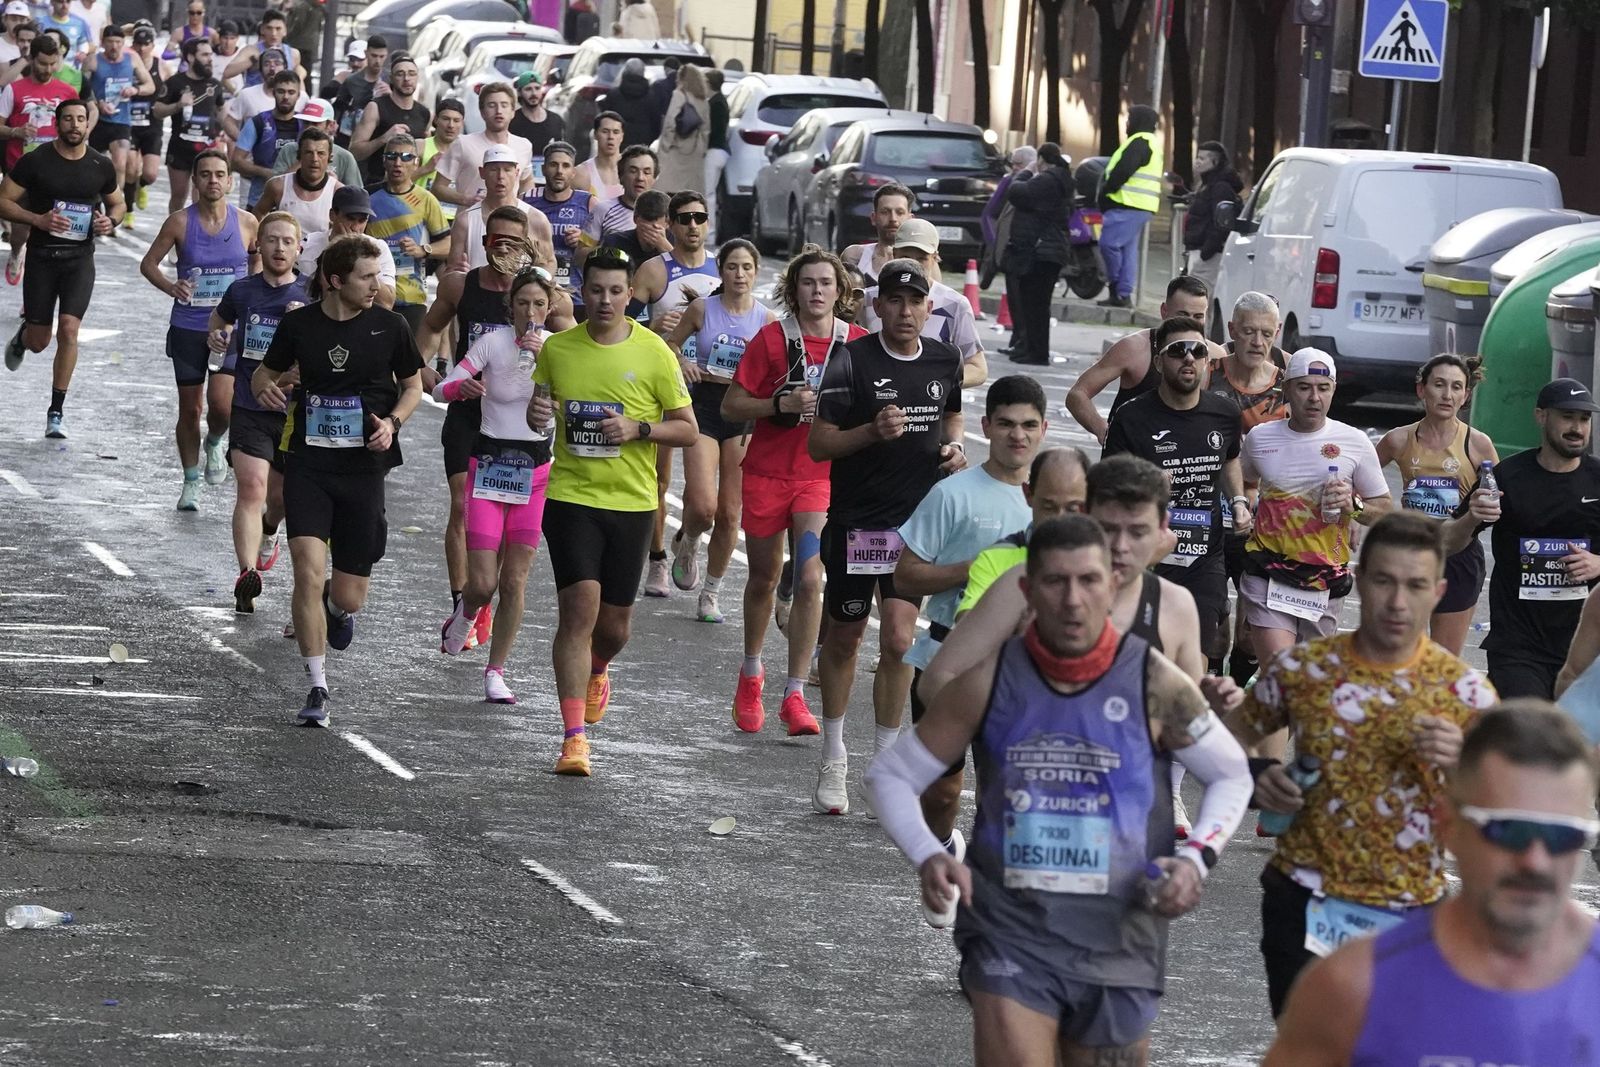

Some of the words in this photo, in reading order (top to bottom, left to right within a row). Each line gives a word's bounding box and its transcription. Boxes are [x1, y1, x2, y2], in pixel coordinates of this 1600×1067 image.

[1363, 304, 1396, 319] 9177
[1401, 306, 1425, 321] MFY
[323, 399, 355, 407] ZURICH
[317, 423, 351, 436] QGS18
[582, 420, 599, 429] 480
[1162, 459, 1180, 467] CLUB
[1181, 455, 1220, 465] ATLETISMO
[482, 476, 525, 492] EDURNE
[1420, 479, 1453, 487] ZURICH
[1173, 512, 1206, 522] ZURICH
[870, 538, 888, 546] 9768
[1177, 542, 1208, 555] CASES
[854, 549, 901, 561] HUERTAS
[1270, 591, 1284, 600] MK
[1285, 595, 1327, 610] CARDENAS
[1023, 768, 1099, 784] SORIA
[1037, 796, 1099, 813] ZURICH
[1010, 843, 1100, 868] DESIUNAI
